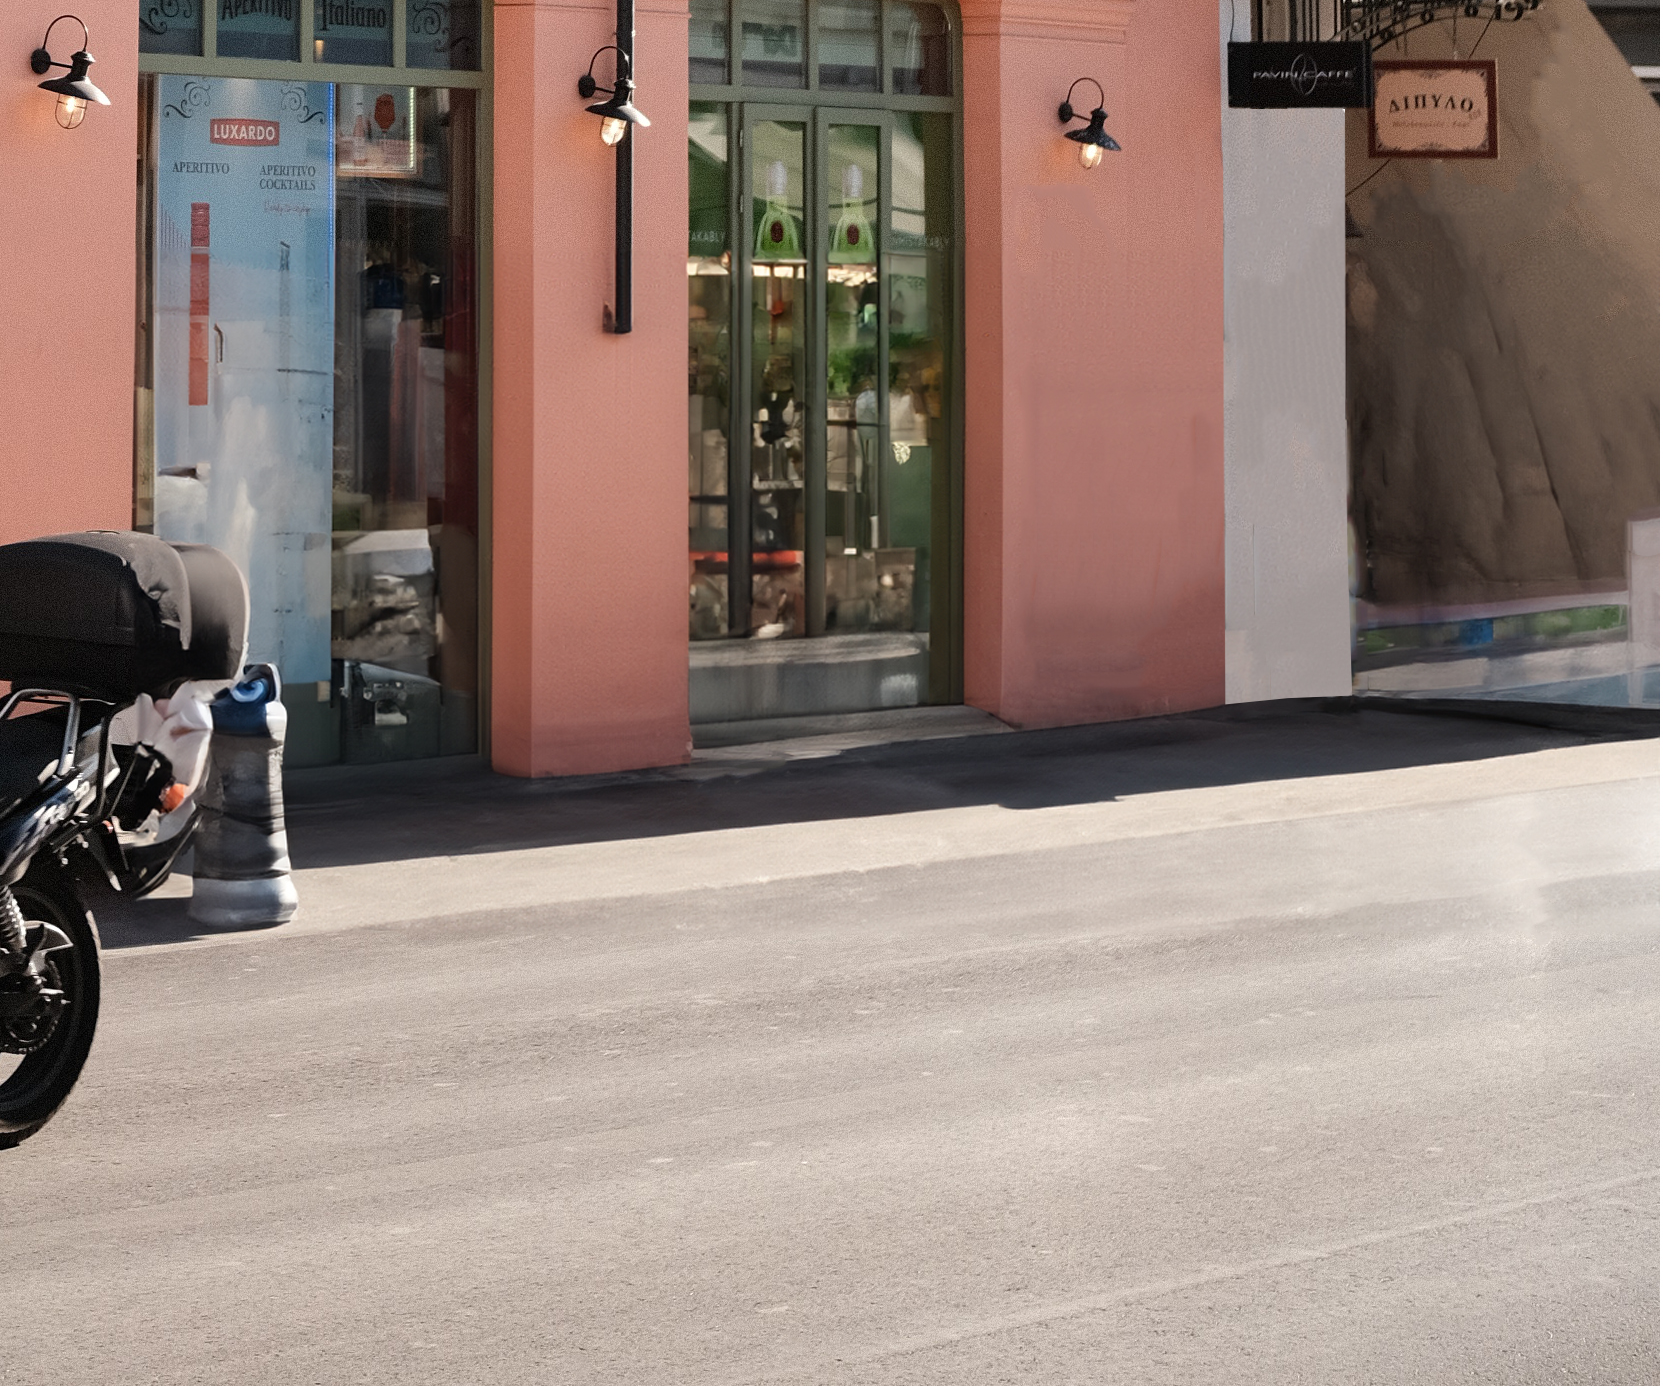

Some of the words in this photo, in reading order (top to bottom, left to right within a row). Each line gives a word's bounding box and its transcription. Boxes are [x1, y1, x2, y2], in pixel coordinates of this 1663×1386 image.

[1389, 93, 1474, 113] ΔΙΠΥΛΟ
[213, 124, 276, 141] LUXARDO
[172, 161, 230, 175] APERITIVO
[259, 164, 317, 177] APERITIVO
[259, 178, 317, 191] COCKTAILS
[689, 230, 726, 243] AKABLY
